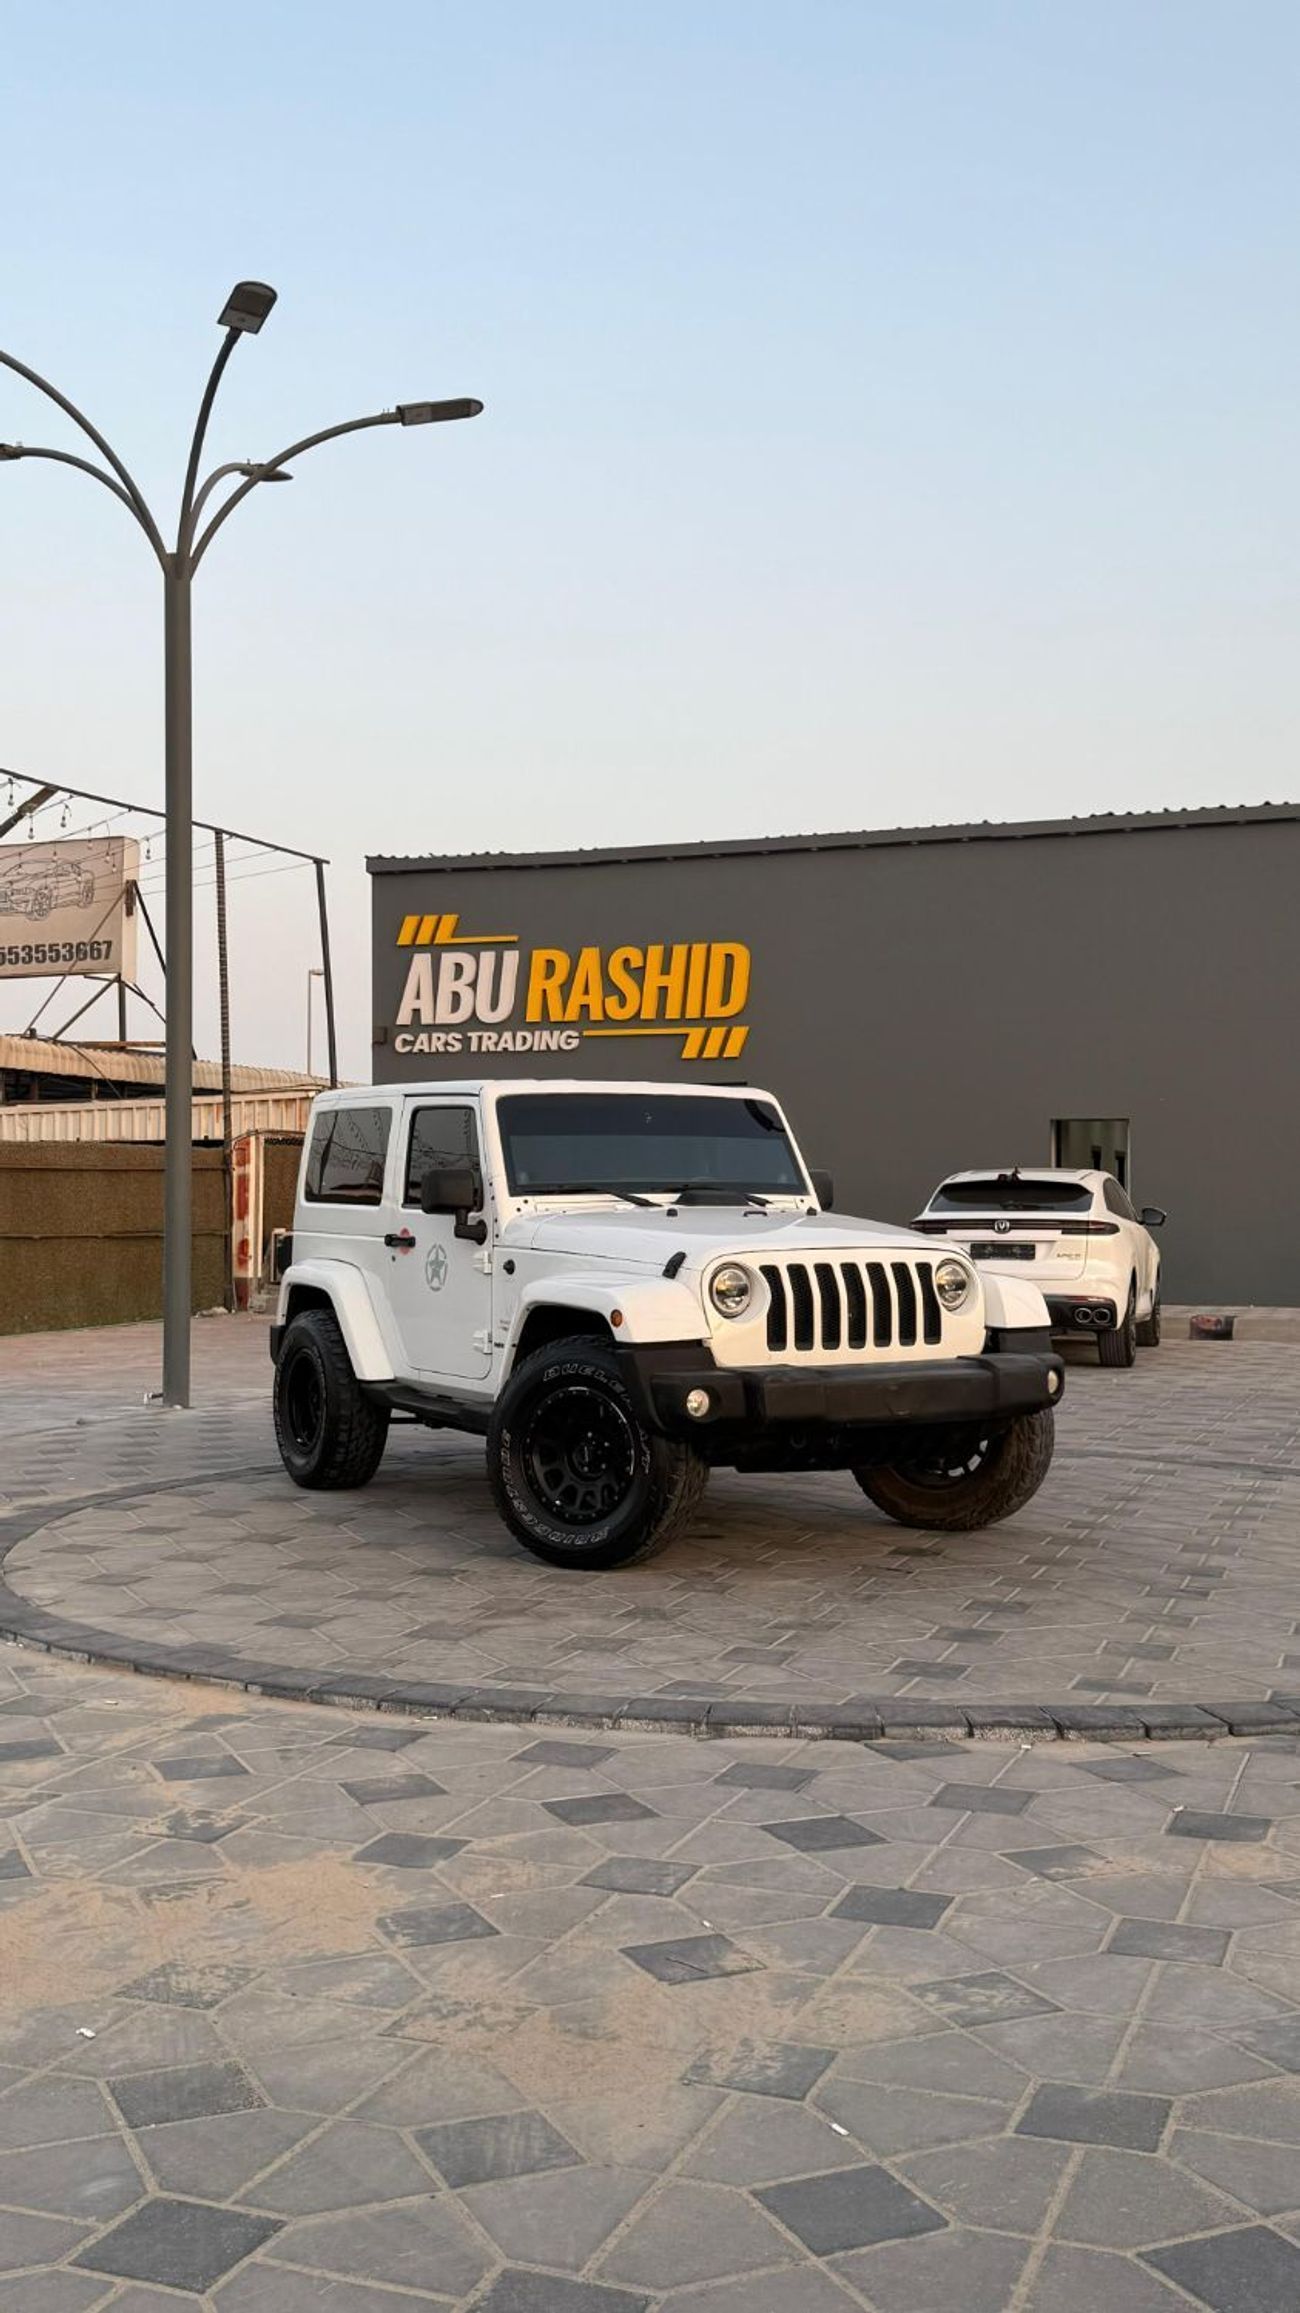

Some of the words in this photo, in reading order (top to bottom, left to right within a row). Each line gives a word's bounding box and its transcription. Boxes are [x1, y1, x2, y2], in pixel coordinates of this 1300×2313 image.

[395, 950, 519, 1025] ABU
[525, 942, 751, 1023] RASHID
[394, 1032, 462, 1053] CARS
[467, 1029, 580, 1052] TRADING
